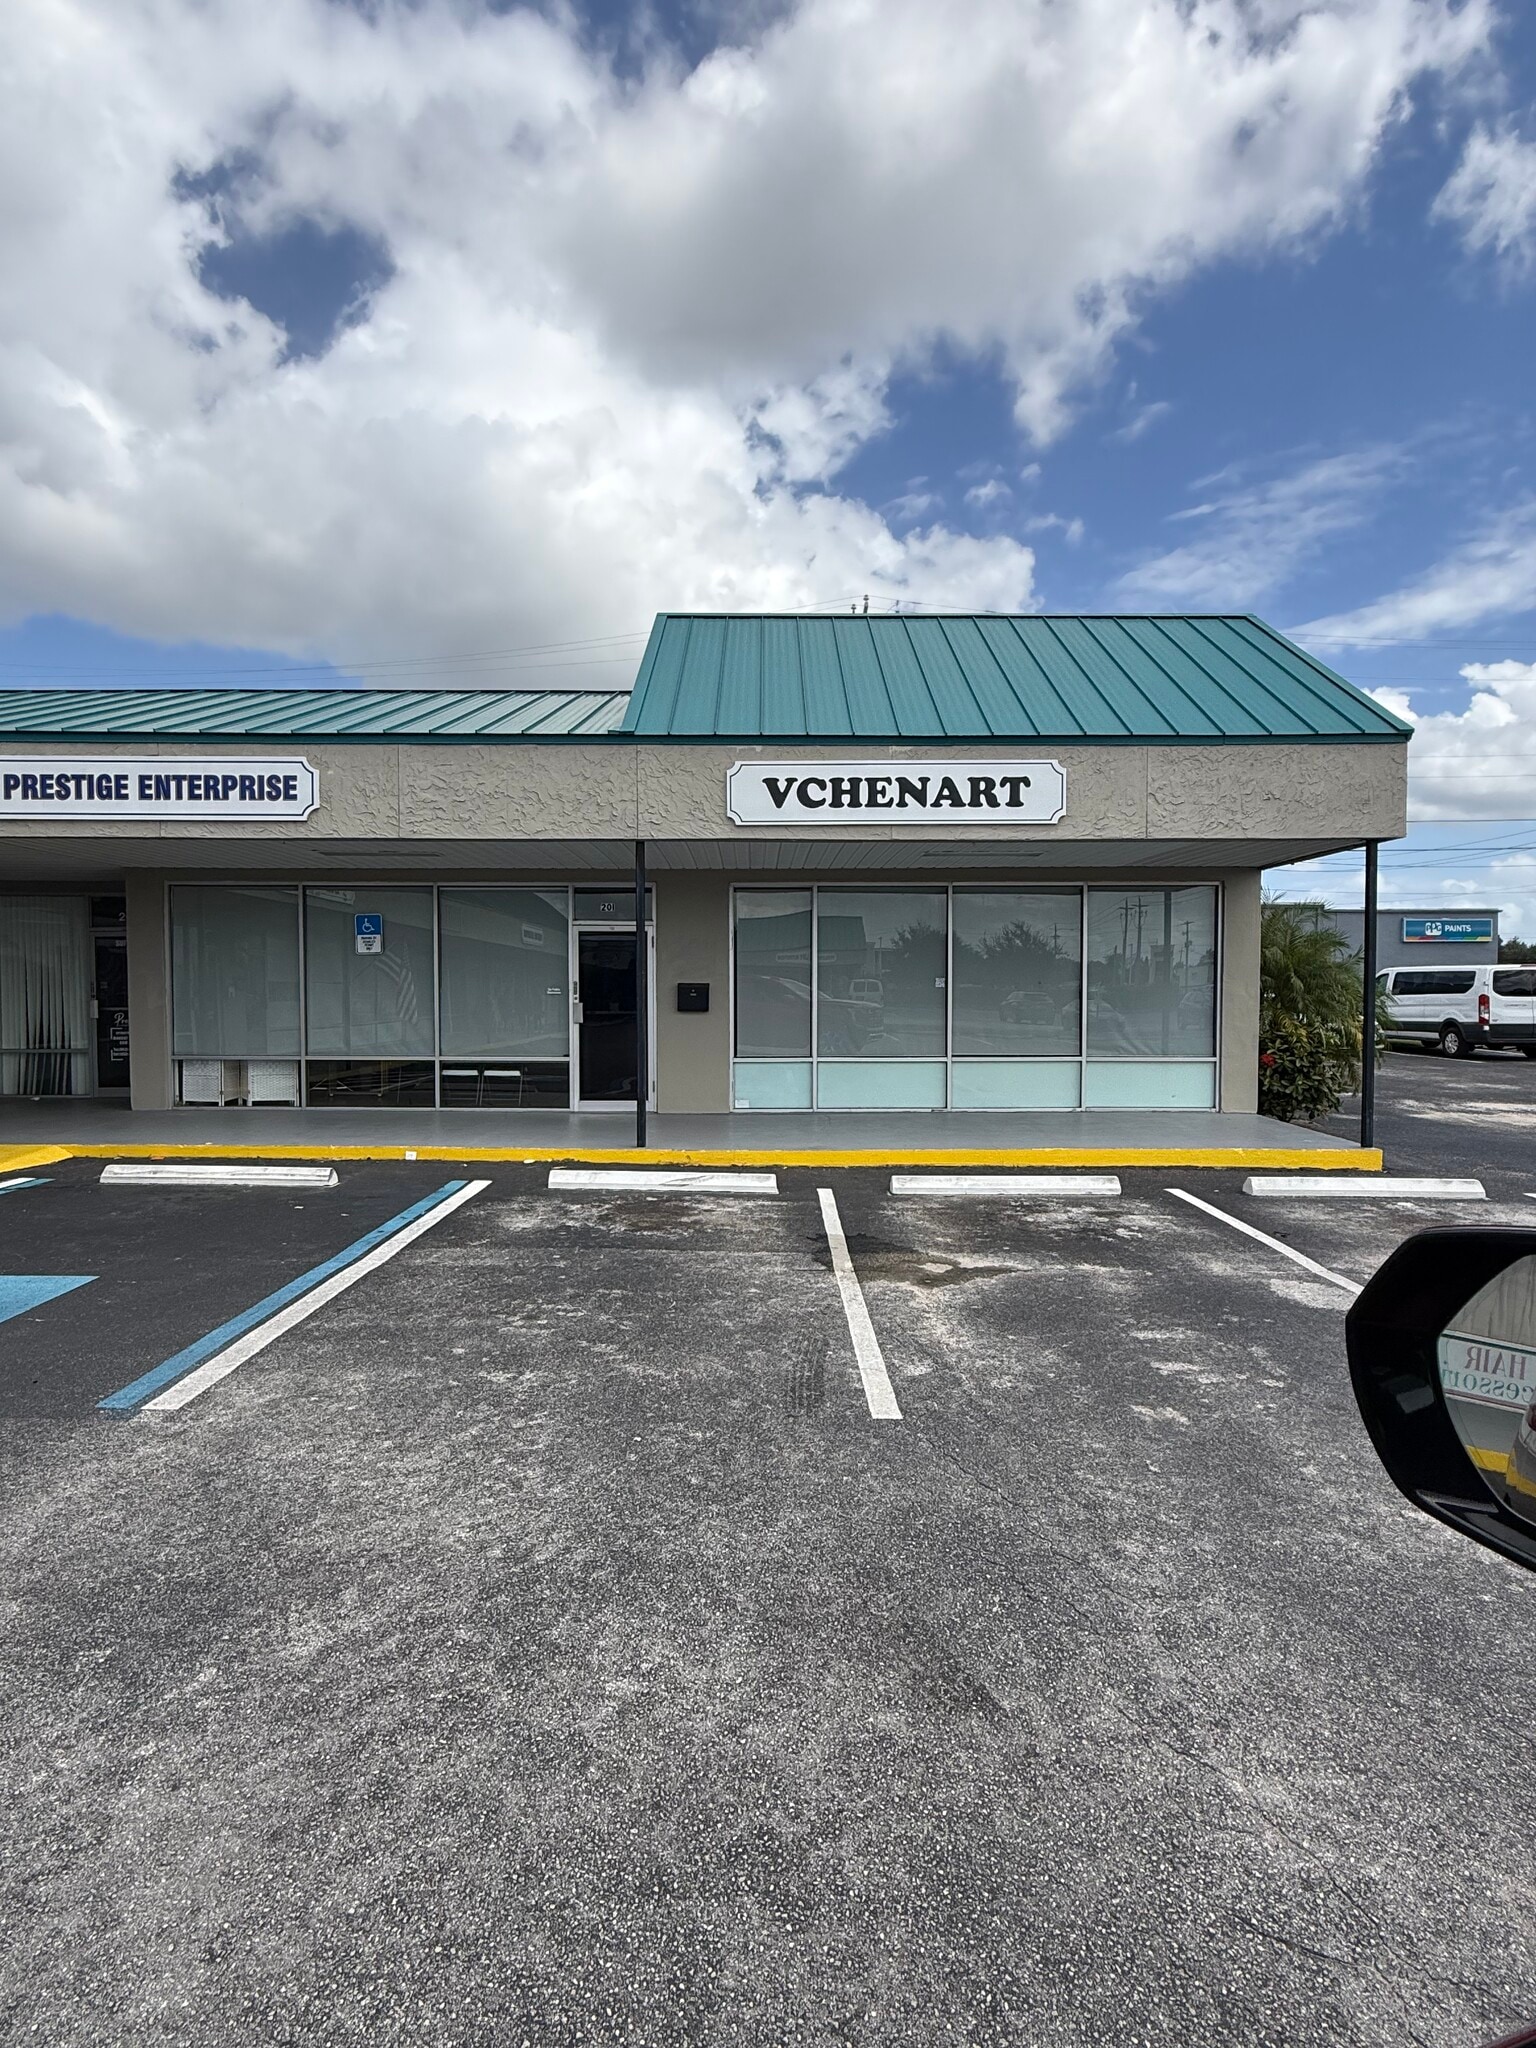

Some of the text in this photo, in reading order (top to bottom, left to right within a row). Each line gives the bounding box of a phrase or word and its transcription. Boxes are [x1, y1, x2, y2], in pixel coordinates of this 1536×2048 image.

[3, 773, 298, 801] PRESTIGE ENTERPRISE
[761, 776, 1032, 809] VCHENART
[601, 903, 615, 911] 201
